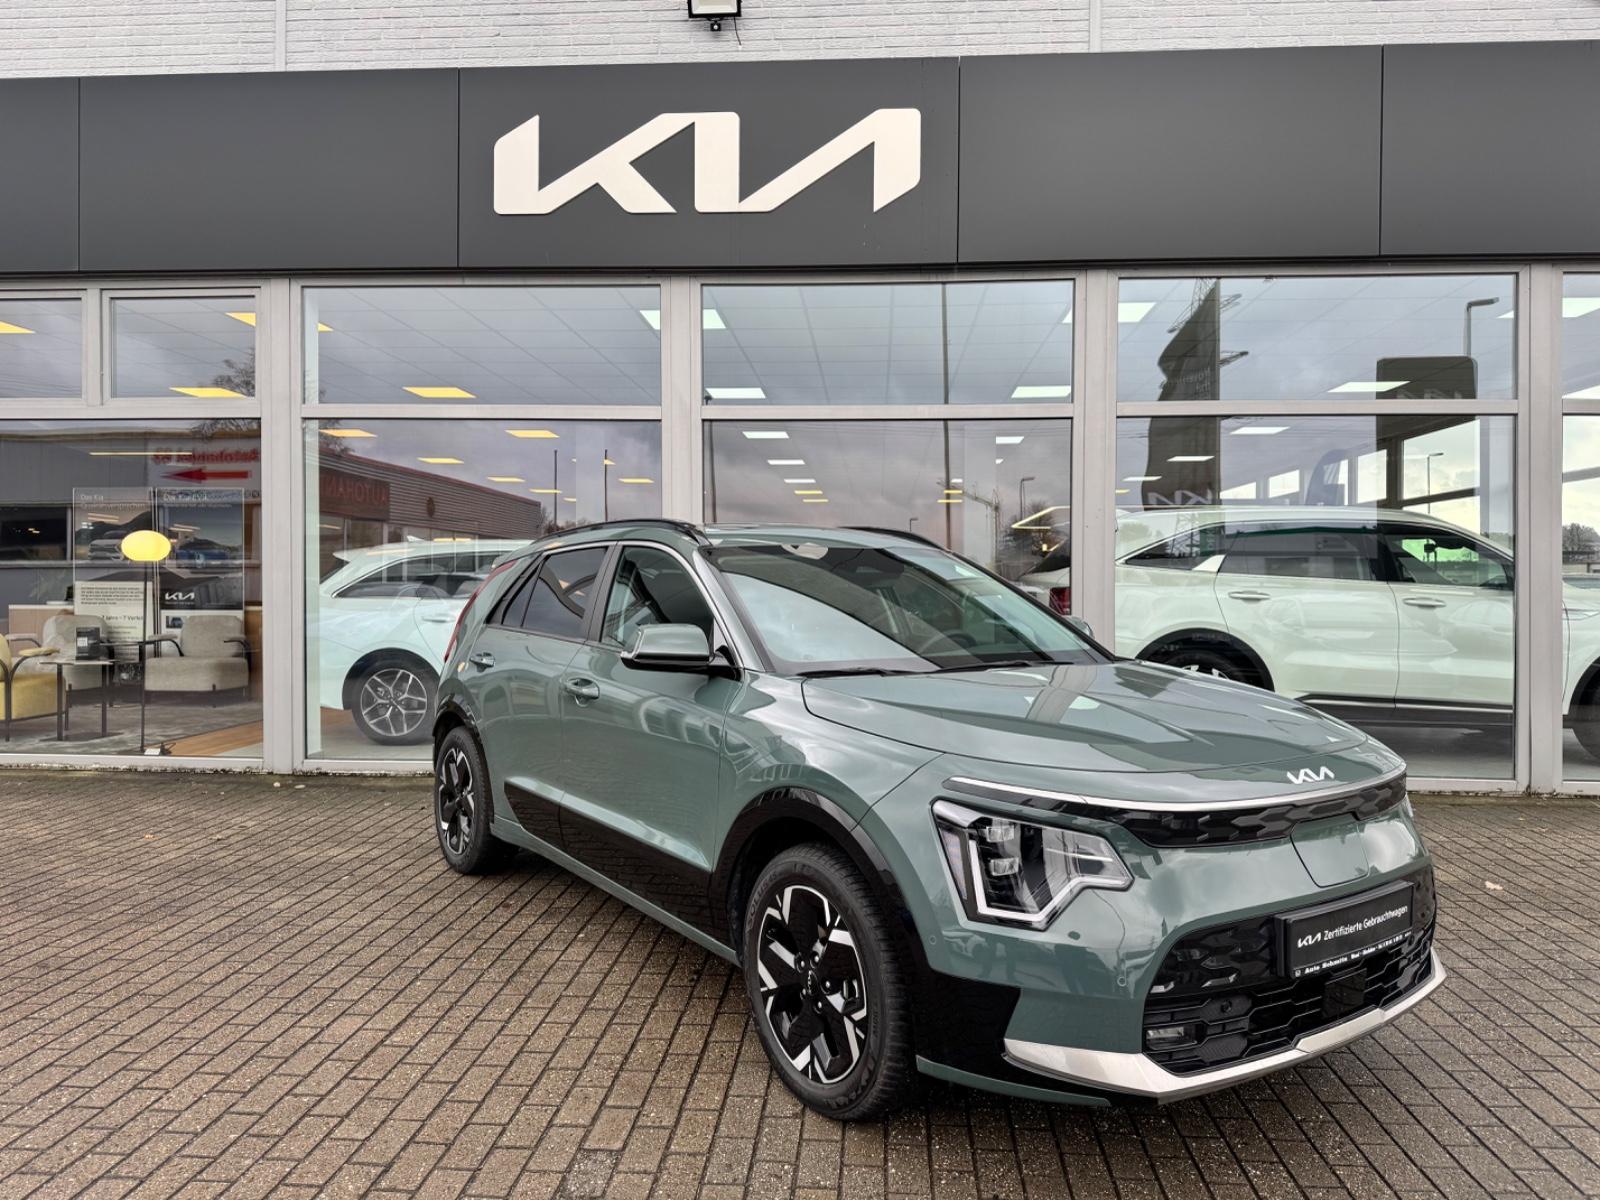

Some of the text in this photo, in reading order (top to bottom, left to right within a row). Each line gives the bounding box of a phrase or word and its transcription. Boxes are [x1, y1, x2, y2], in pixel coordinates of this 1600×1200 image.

[494, 108, 921, 215] KIA
[165, 592, 195, 601] KIA
[1286, 766, 1335, 784] KIA
[1297, 905, 1408, 948] KIA Zertifizierte Gebrauchtwagen
